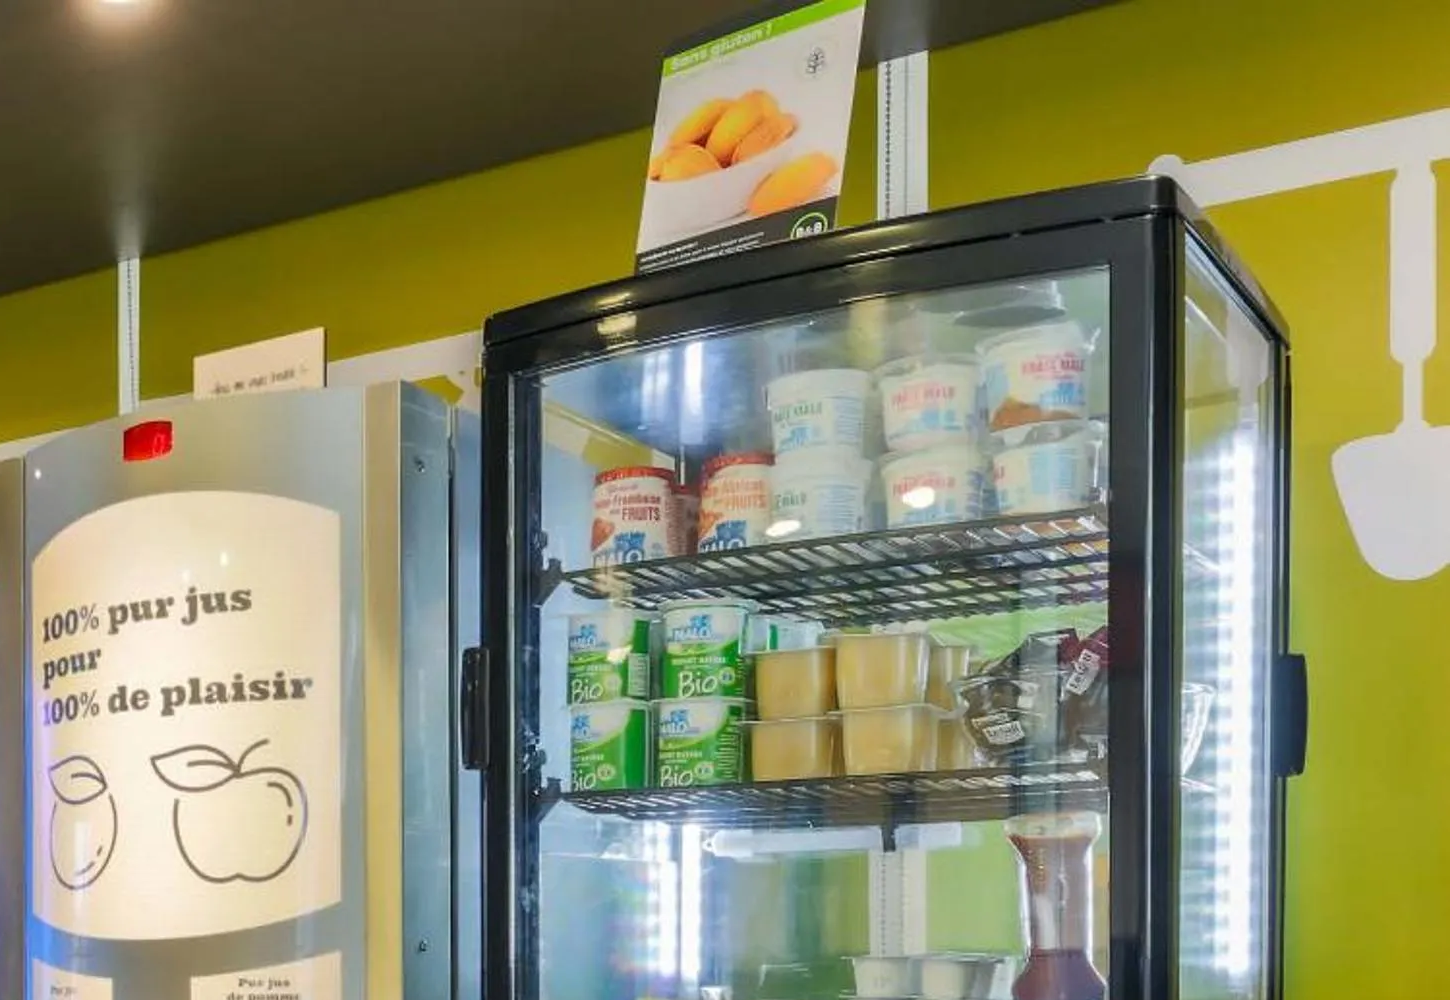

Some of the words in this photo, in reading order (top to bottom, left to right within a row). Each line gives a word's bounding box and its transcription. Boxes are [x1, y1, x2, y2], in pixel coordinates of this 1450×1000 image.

[43, 604, 100, 644] 100%
[107, 595, 174, 635] pur
[181, 586, 253, 626] jus
[43, 649, 102, 690] pour
[679, 670, 718, 698] Bio
[43, 689, 100, 726] 100%
[107, 685, 151, 714] de
[160, 671, 314, 717] plaisir
[660, 764, 694, 787] Bio
